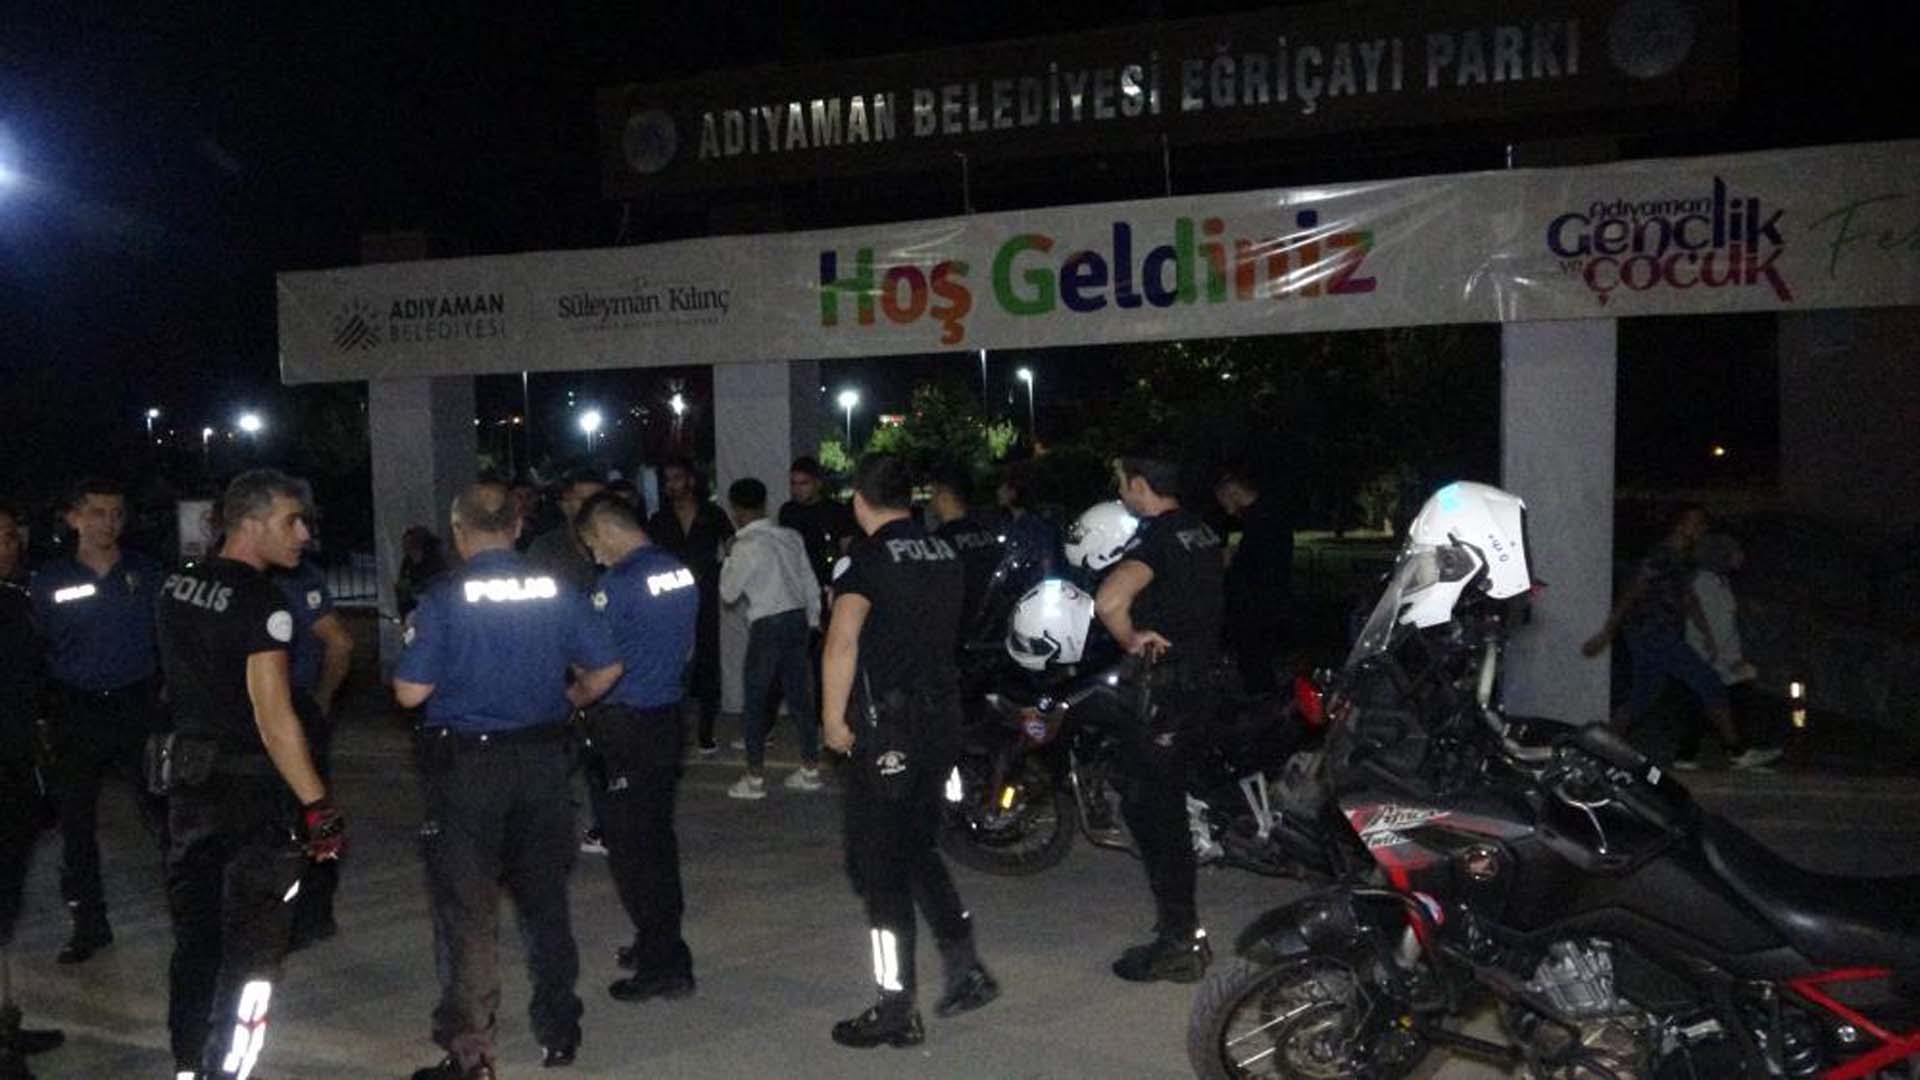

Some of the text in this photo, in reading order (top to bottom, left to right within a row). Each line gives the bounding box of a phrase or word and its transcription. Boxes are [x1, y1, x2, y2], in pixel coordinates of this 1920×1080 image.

[699, 92, 896, 158] ADIYAMAN
[912, 50, 1162, 137] BELEDİYESİ
[1547, 175, 1784, 262] Gençlik
[389, 294, 504, 321] ADIYAMAN
[819, 209, 1377, 345] Hoş Geldiniz
